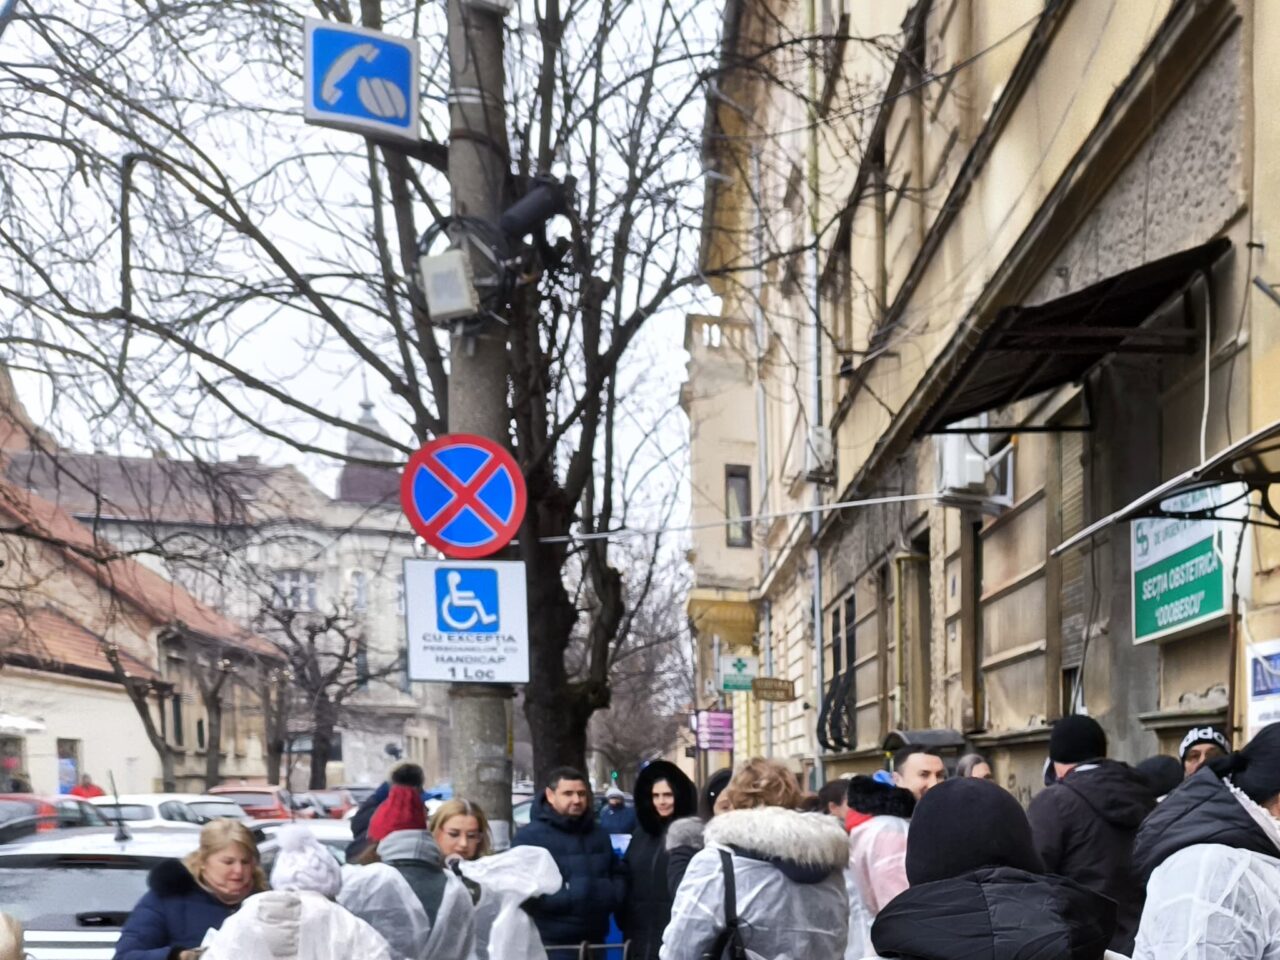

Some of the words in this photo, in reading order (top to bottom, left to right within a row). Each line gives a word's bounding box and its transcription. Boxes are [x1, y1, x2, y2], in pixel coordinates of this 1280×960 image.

[1142, 571, 1168, 601] SECȚIA
[422, 633, 442, 642] CU
[435, 655, 506, 664] HANDICAP
[448, 667, 457, 678] 1
[463, 667, 496, 680] Loc
